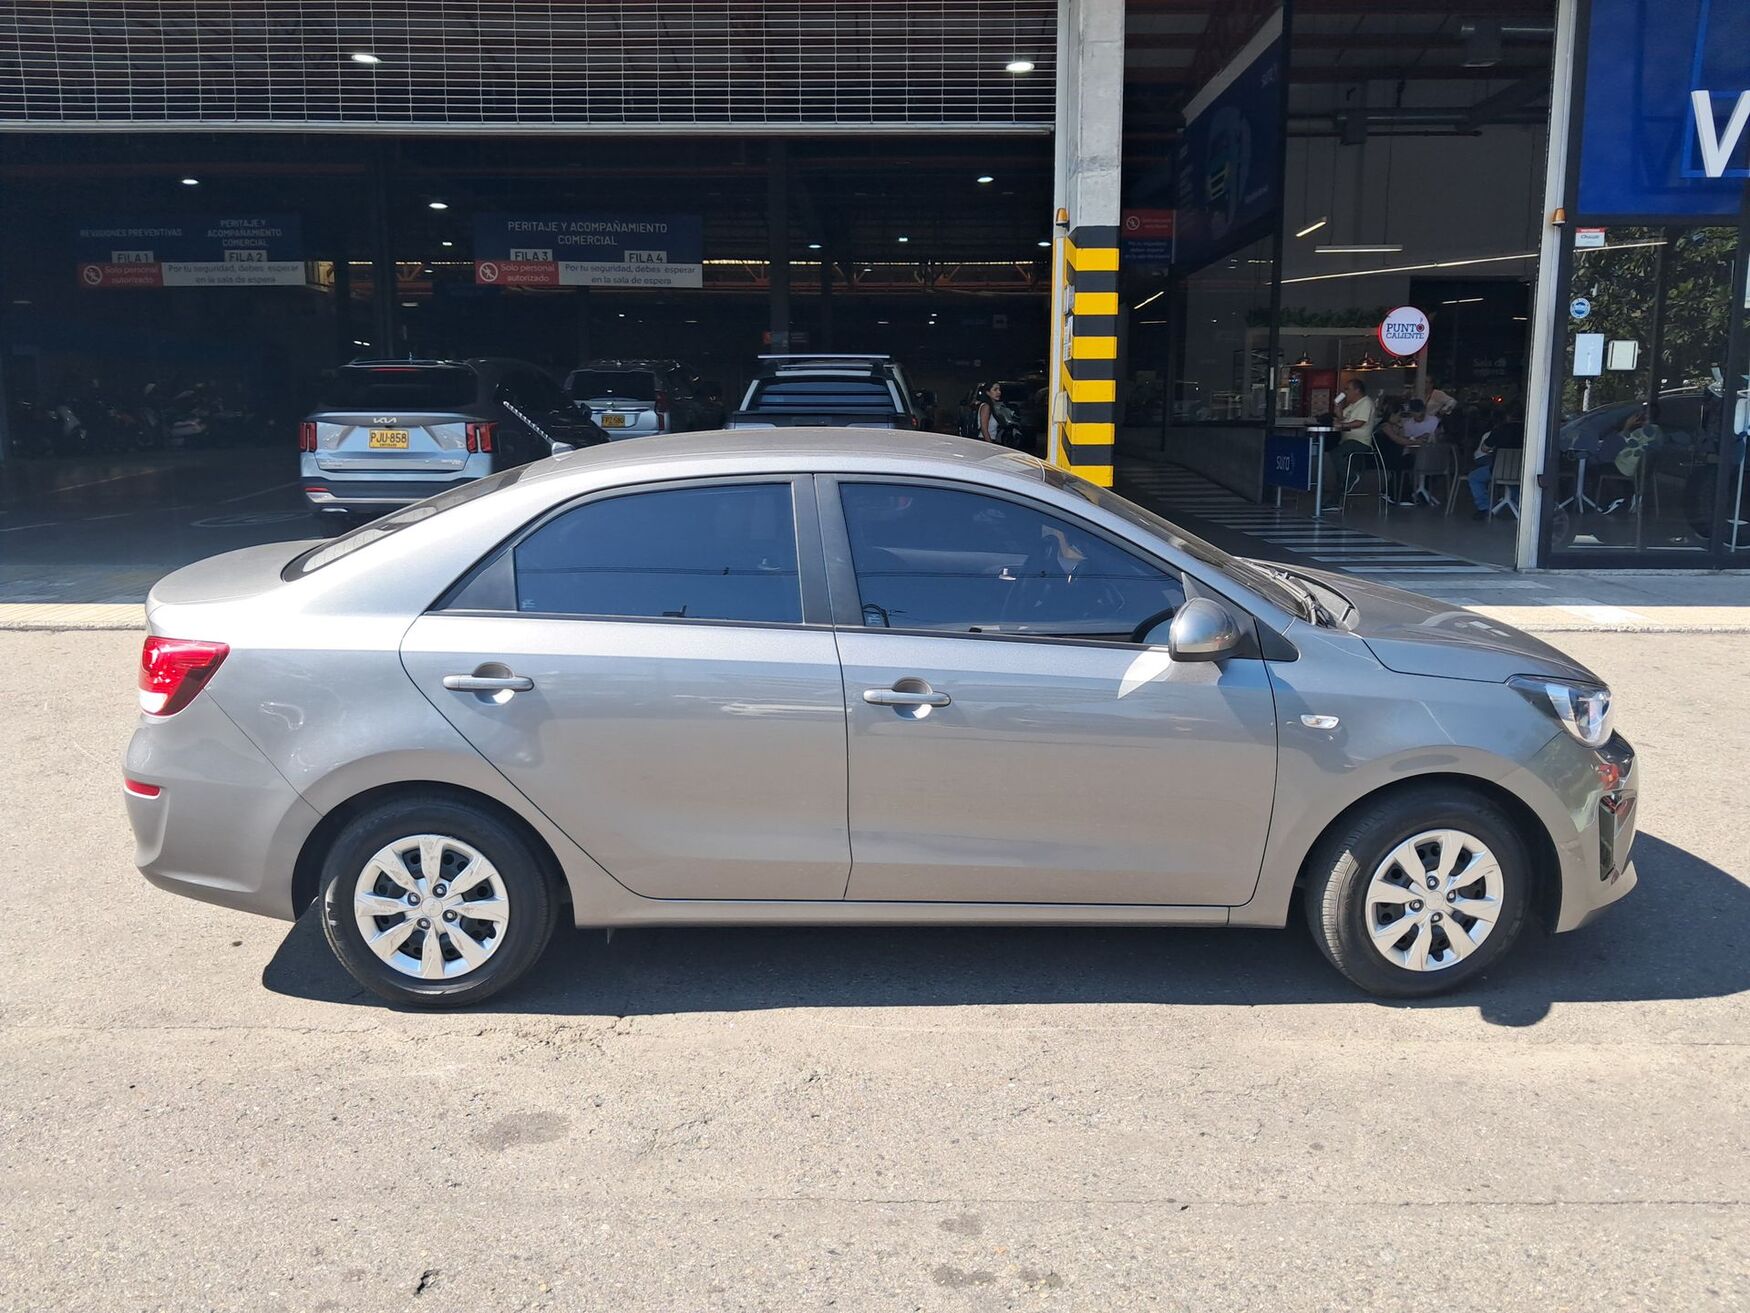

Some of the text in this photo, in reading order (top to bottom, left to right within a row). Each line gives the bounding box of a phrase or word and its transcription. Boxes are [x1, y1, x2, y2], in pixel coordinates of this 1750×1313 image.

[1691, 90, 1750, 178] V
[508, 220, 668, 233] PERITAJE Y ACOMPAÑAMIENTO
[222, 238, 268, 247] COMERCIAL
[558, 235, 618, 246] COMERCIAL
[117, 253, 141, 263] FILA
[229, 252, 263, 262] FILA 2
[515, 251, 549, 261] FILA 3
[629, 253, 664, 263] FILA 4
[168, 264, 182, 273] Por
[500, 263, 555, 274] Solo personal
[565, 263, 579, 273] Por
[580, 263, 589, 273] tu
[635, 266, 661, 274] debes
[664, 267, 696, 275] esperar
[507, 274, 550, 283] autorizado
[604, 276, 612, 284] la
[613, 276, 630, 285] sala
[631, 276, 642, 285] de
[644, 277, 672, 286] espera
[1386, 323, 1425, 333] PUNTO
[1386, 332, 1425, 340] CALIENTE
